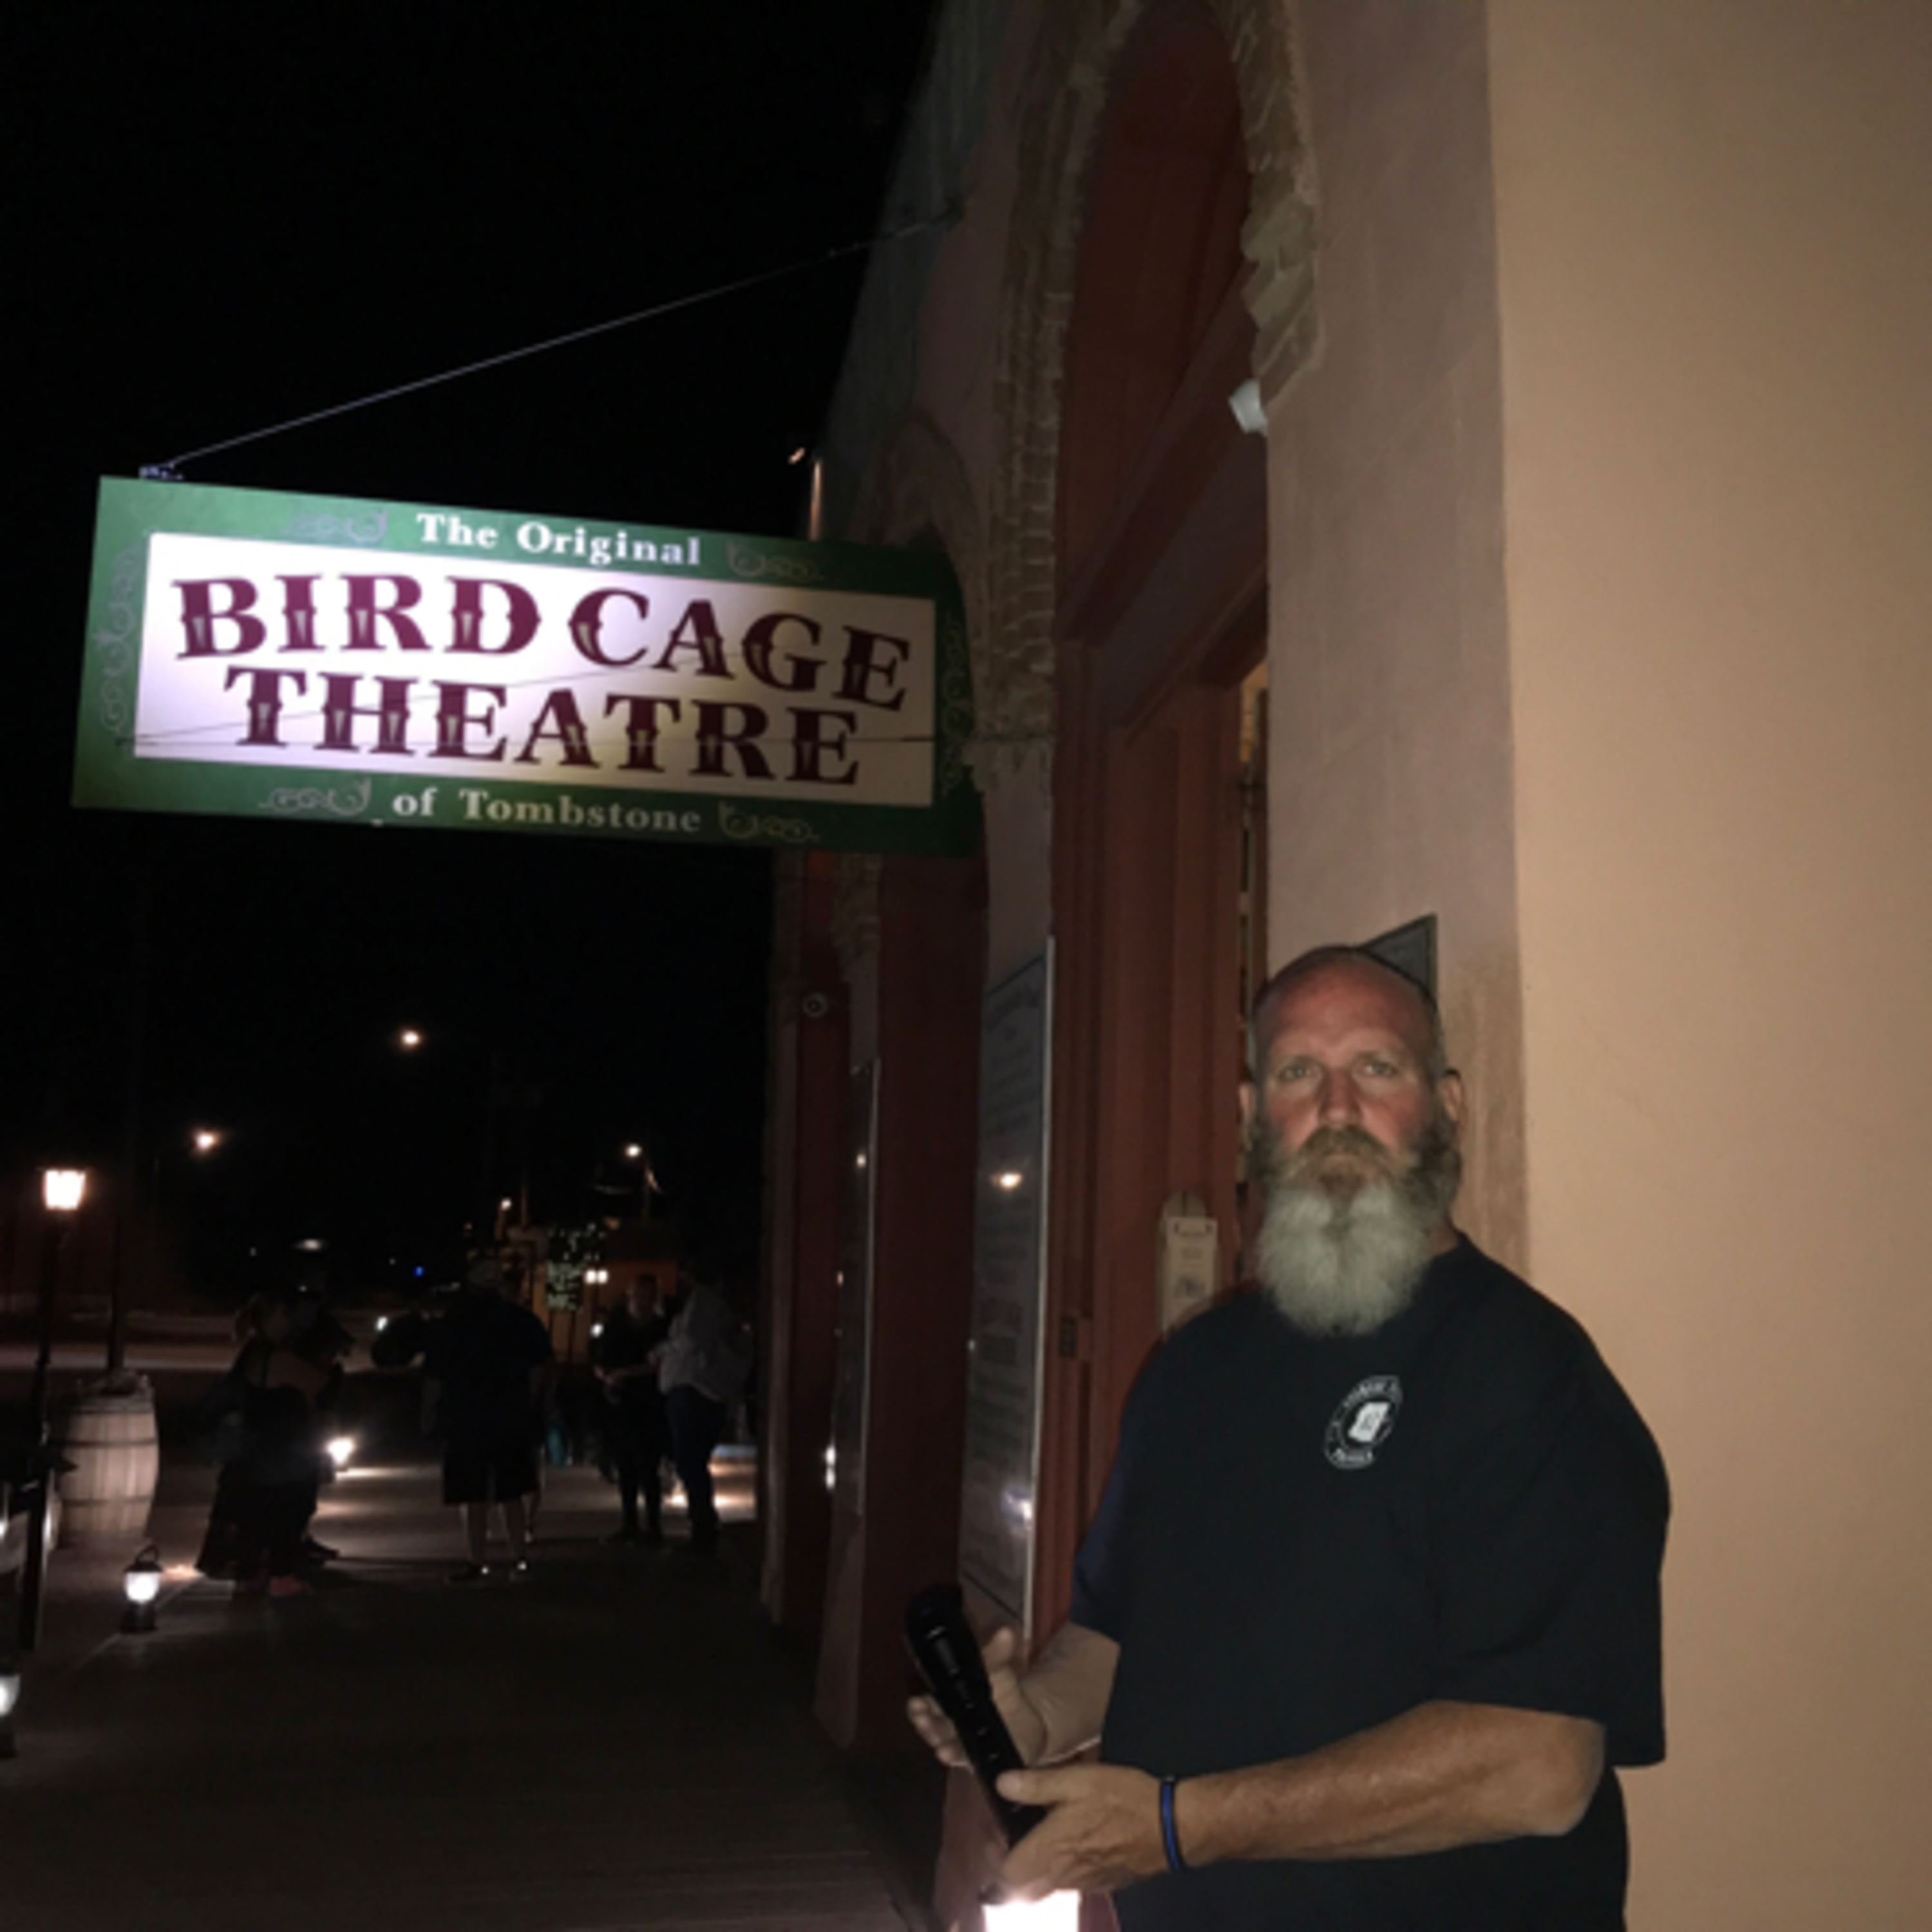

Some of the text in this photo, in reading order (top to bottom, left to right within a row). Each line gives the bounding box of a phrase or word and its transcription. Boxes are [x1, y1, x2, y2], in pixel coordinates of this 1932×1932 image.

[417, 513, 700, 565] The Original
[171, 573, 910, 711] BIRD CAGE
[223, 665, 859, 786] THEATRE
[392, 787, 702, 832] of Tombstone
